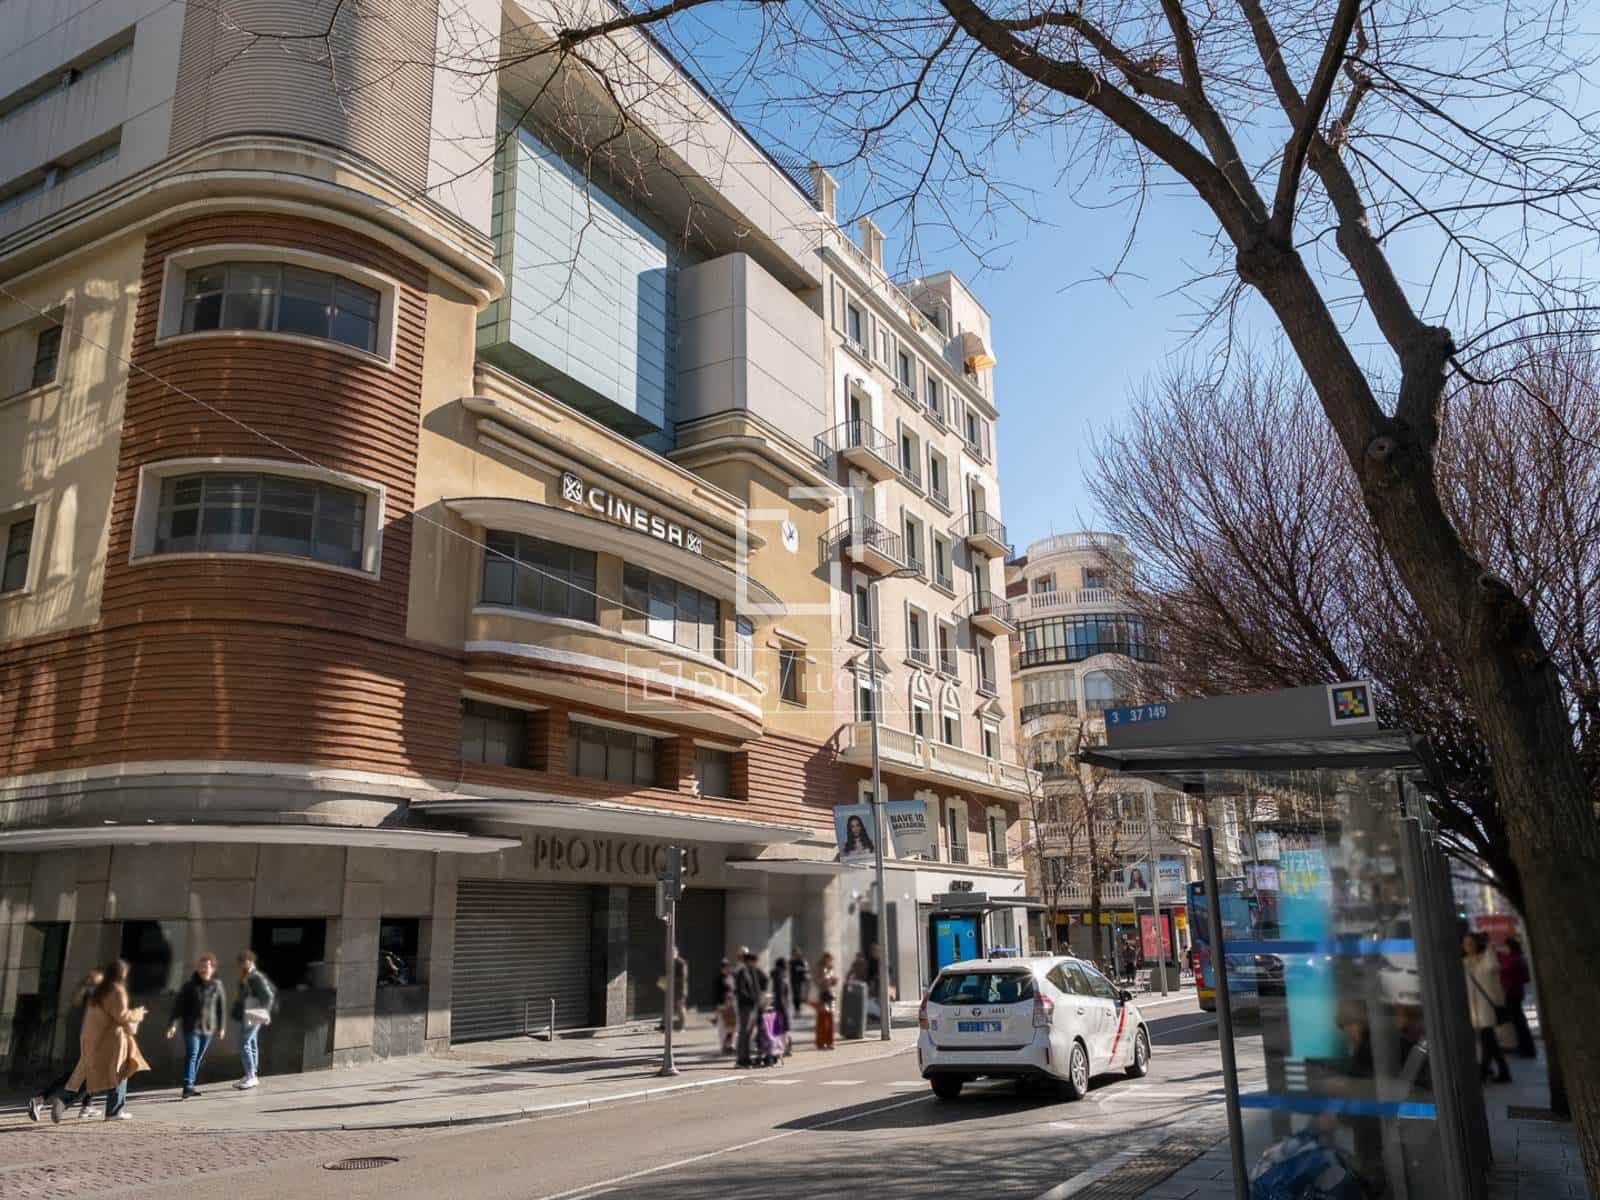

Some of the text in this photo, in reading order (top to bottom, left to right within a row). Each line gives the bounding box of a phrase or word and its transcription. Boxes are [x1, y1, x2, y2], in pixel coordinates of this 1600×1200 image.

[588, 487, 683, 546] CINESA
[1111, 705, 1167, 722] 3 37 149
[1236, 881, 1244, 892] 3
